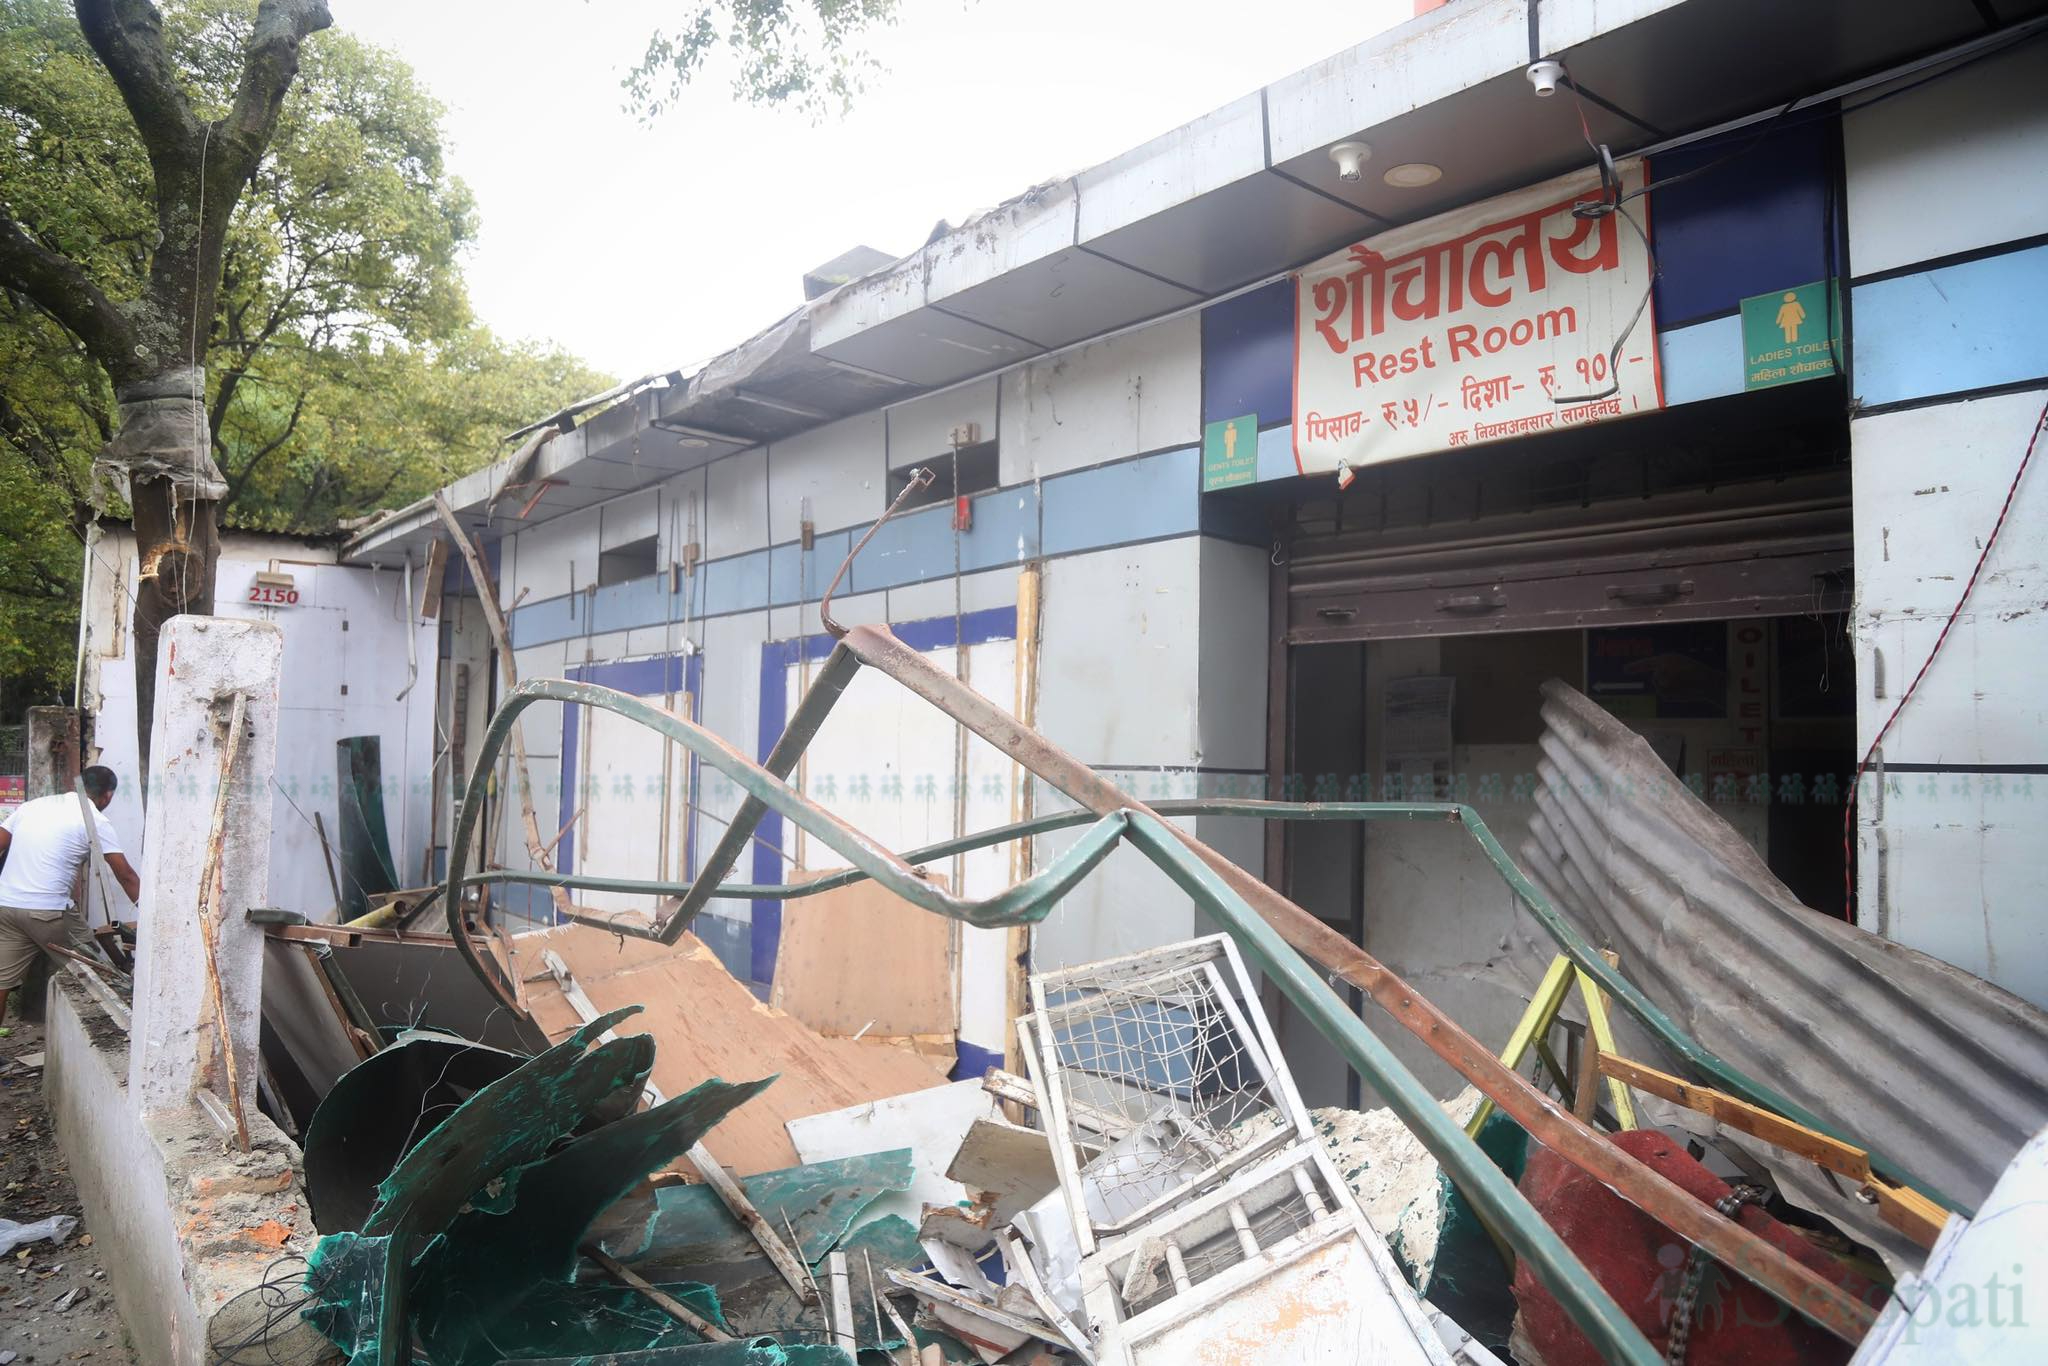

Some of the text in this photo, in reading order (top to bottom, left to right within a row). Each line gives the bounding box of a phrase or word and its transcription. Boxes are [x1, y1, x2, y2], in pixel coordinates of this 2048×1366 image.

[1312, 180, 1623, 354] शौचालय
[1352, 305, 1577, 388] Rest Room
[1750, 337, 1840, 365] LADIES TOILET
[1460, 374, 1525, 412] दिशा-
[1751, 366, 1786, 382] महिला
[249, 587, 299, 604] 2150
[1736, 627, 1763, 743] OILET
